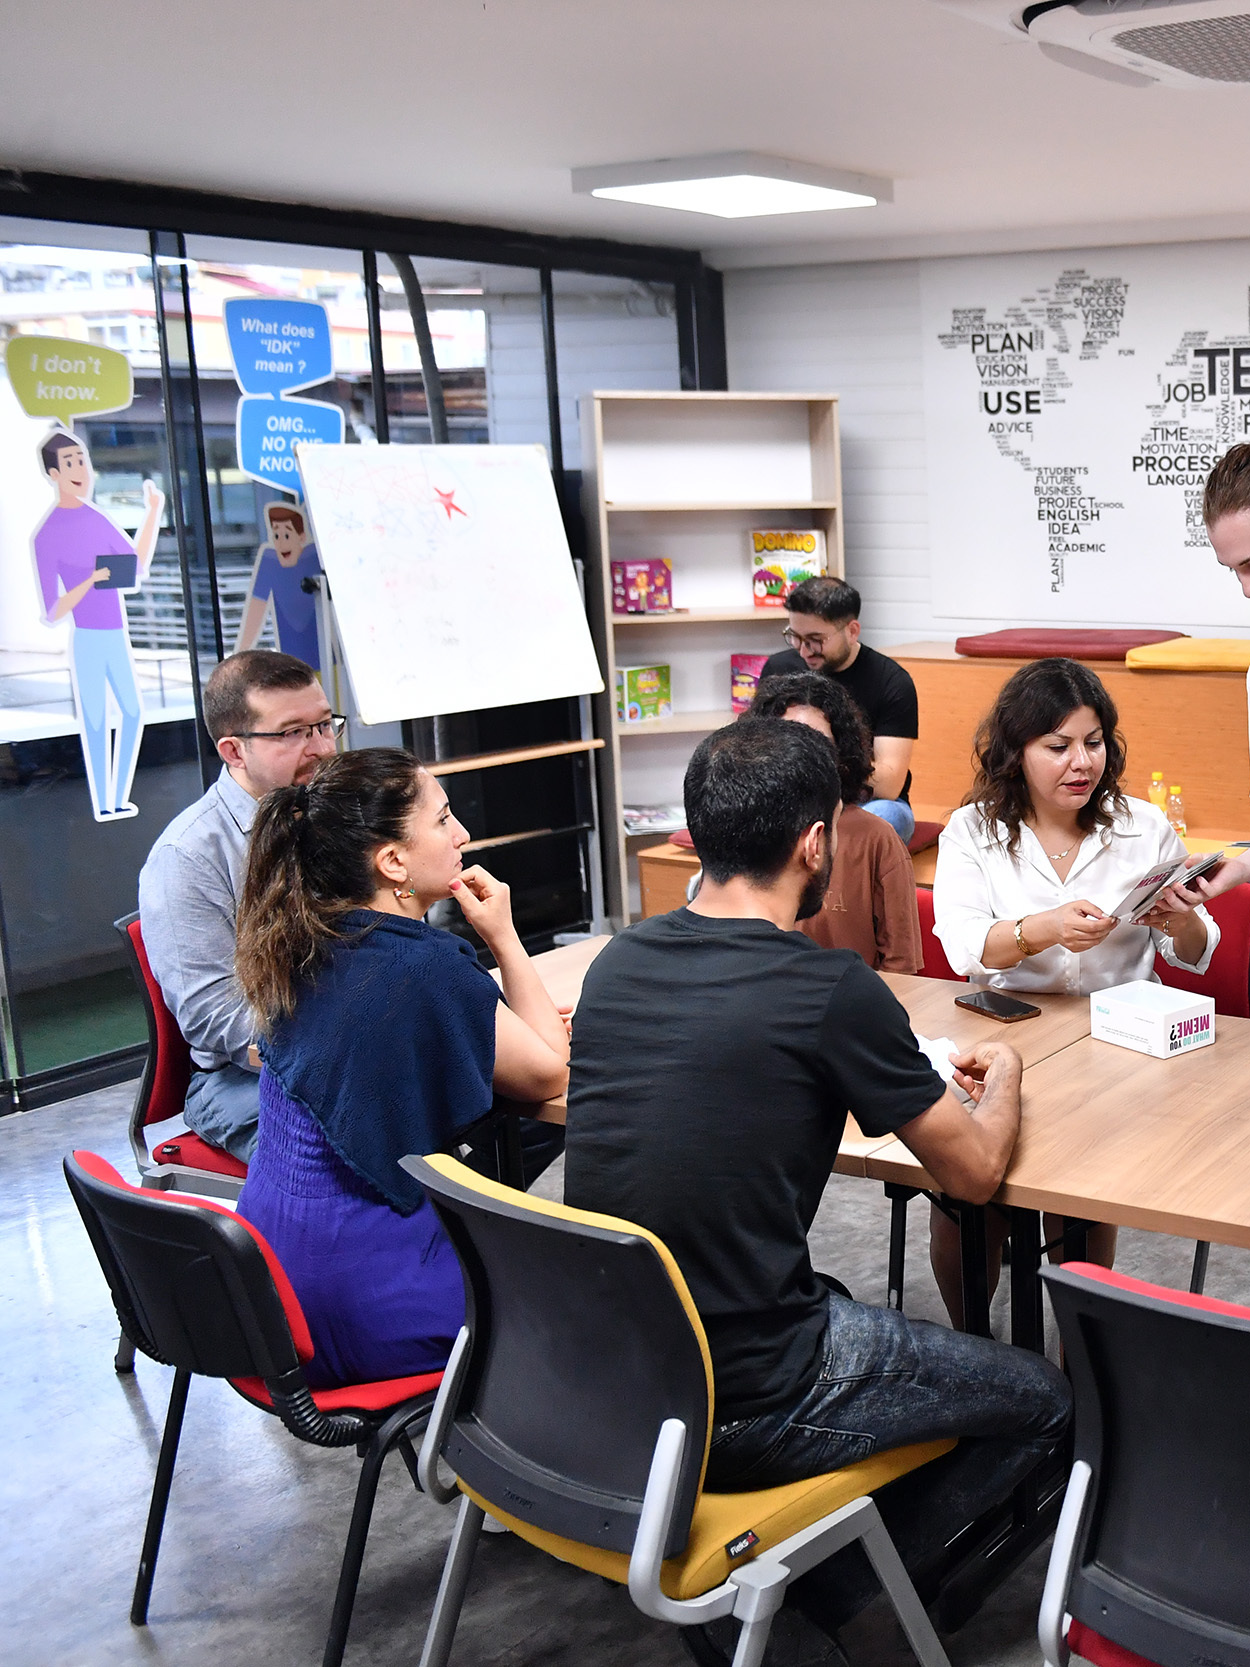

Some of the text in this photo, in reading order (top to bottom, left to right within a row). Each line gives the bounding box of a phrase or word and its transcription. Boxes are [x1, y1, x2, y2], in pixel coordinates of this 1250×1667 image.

[1082, 284, 1128, 296] PROJECT
[1074, 296, 1126, 308] SUCCESS
[1082, 308, 1124, 320] VISION
[242, 318, 315, 339] What does
[952, 323, 1008, 332] MOTIVATION
[1084, 320, 1120, 329] TARGET
[1086, 330, 1120, 339] ACTION
[972, 332, 1034, 354] PLAN
[31, 354, 38, 372] I
[976, 356, 1027, 364] EDUCATION
[255, 360, 306, 374] mean ?
[977, 364, 1028, 378] VISION
[36, 381, 100, 400] know.
[1164, 383, 1206, 404] JOB
[983, 391, 1042, 415] USE
[1220, 360, 1230, 444] KNOWLEDGE
[988, 422, 1033, 433] ADVICE
[1150, 427, 1188, 442] TIME
[262, 436, 286, 452] NO
[1141, 443, 1218, 454] MOTIVATION
[260, 456, 300, 472] KNO
[1037, 468, 1089, 476] STUDENTS
[1036, 476, 1075, 485] FUTURE
[1148, 475, 1205, 486] LANGUA
[1034, 487, 1082, 496] BUSINESS
[1038, 498, 1096, 509] PROJECT
[1184, 498, 1203, 509] VIS
[1038, 510, 1100, 521] ENGLISH
[1049, 523, 1080, 535] IDEA
[1048, 544, 1106, 553] ACADEMIC
[1052, 558, 1060, 592] PLAN
[1170, 1014, 1210, 1041] MEME?
[1170, 1030, 1210, 1051] WHAT DO YOU
